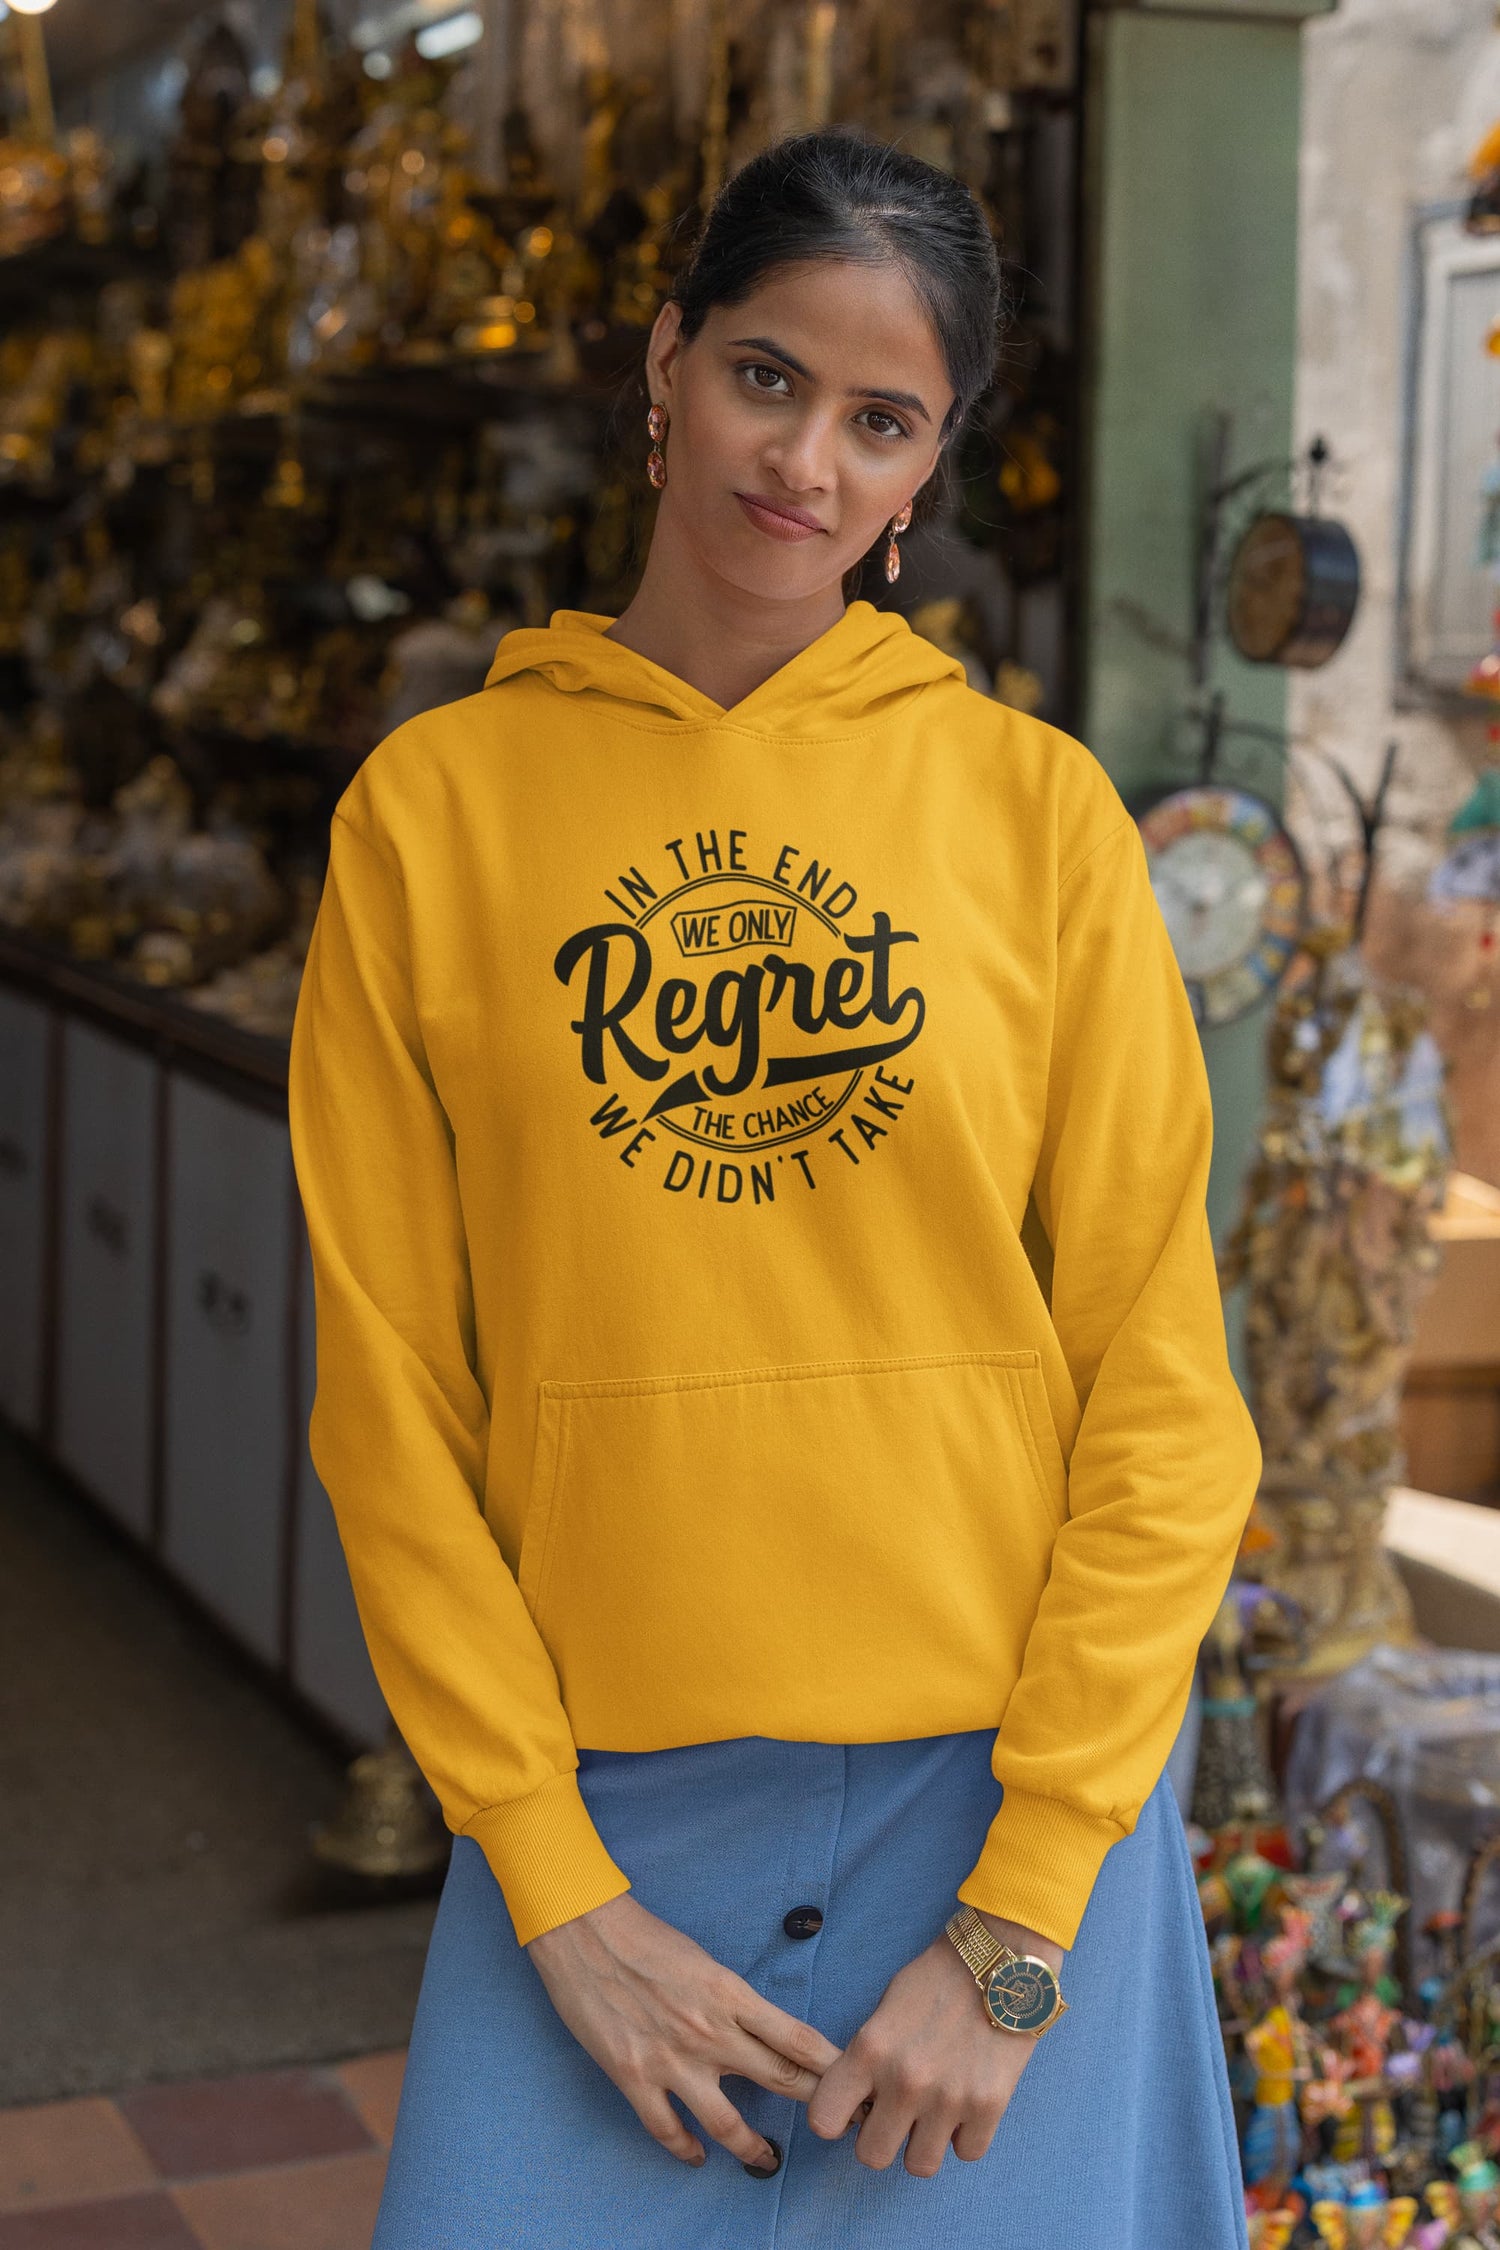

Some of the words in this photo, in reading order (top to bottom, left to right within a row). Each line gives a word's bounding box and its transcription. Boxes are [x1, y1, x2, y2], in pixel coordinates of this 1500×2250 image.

[604, 866, 658, 920] IN
[665, 829, 747, 881] THE
[773, 845, 858, 919] END
[681, 915, 721, 948] WE
[728, 909, 792, 944] ONLY
[553, 911, 926, 1097] Regret
[589, 1092, 656, 1169] WE
[663, 1149, 816, 1205] DIDN'T
[827, 1065, 915, 1165] TAKE
[692, 1105, 736, 1140] THE
[743, 1086, 835, 1139] CHANCE
